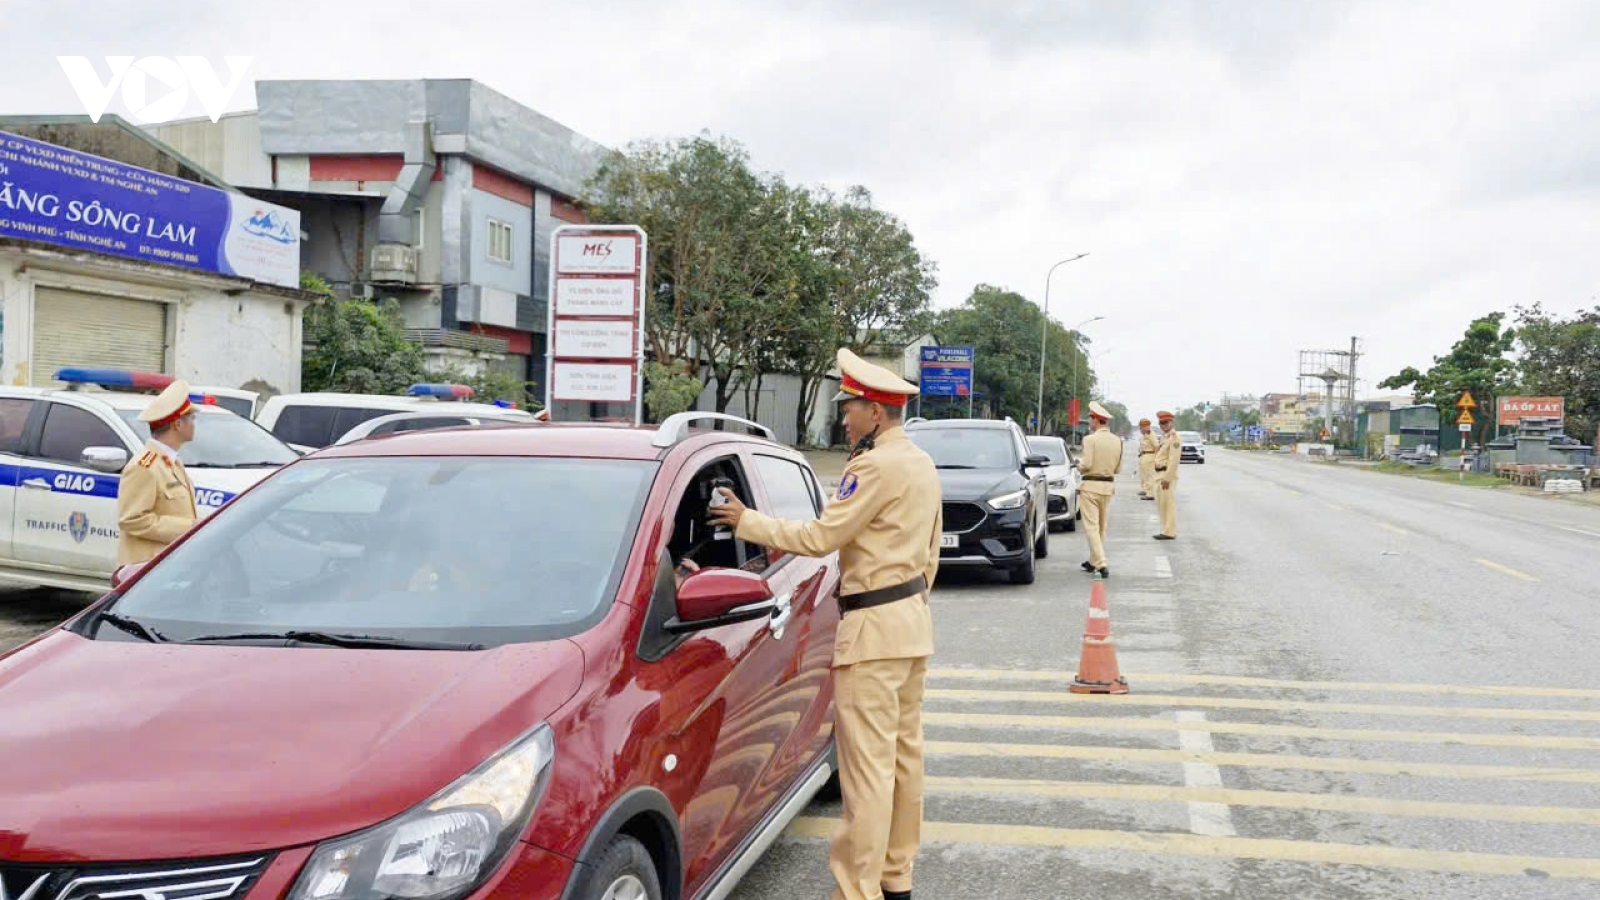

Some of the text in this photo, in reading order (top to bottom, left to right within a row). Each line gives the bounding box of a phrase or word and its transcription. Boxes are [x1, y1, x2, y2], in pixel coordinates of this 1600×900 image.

[7, 140, 24, 150] CP
[25, 145, 55, 158] VLXD
[85, 161, 119, 175] TRUNG
[61, 165, 90, 178] VLXD
[100, 175, 115, 185] TM
[145, 187, 158, 196] AN
[0, 181, 196, 246] ĂNG SÔNG LAM
[54, 473, 224, 506] GIAO NG
[26, 519, 120, 539] TRAFFIC POLIC
